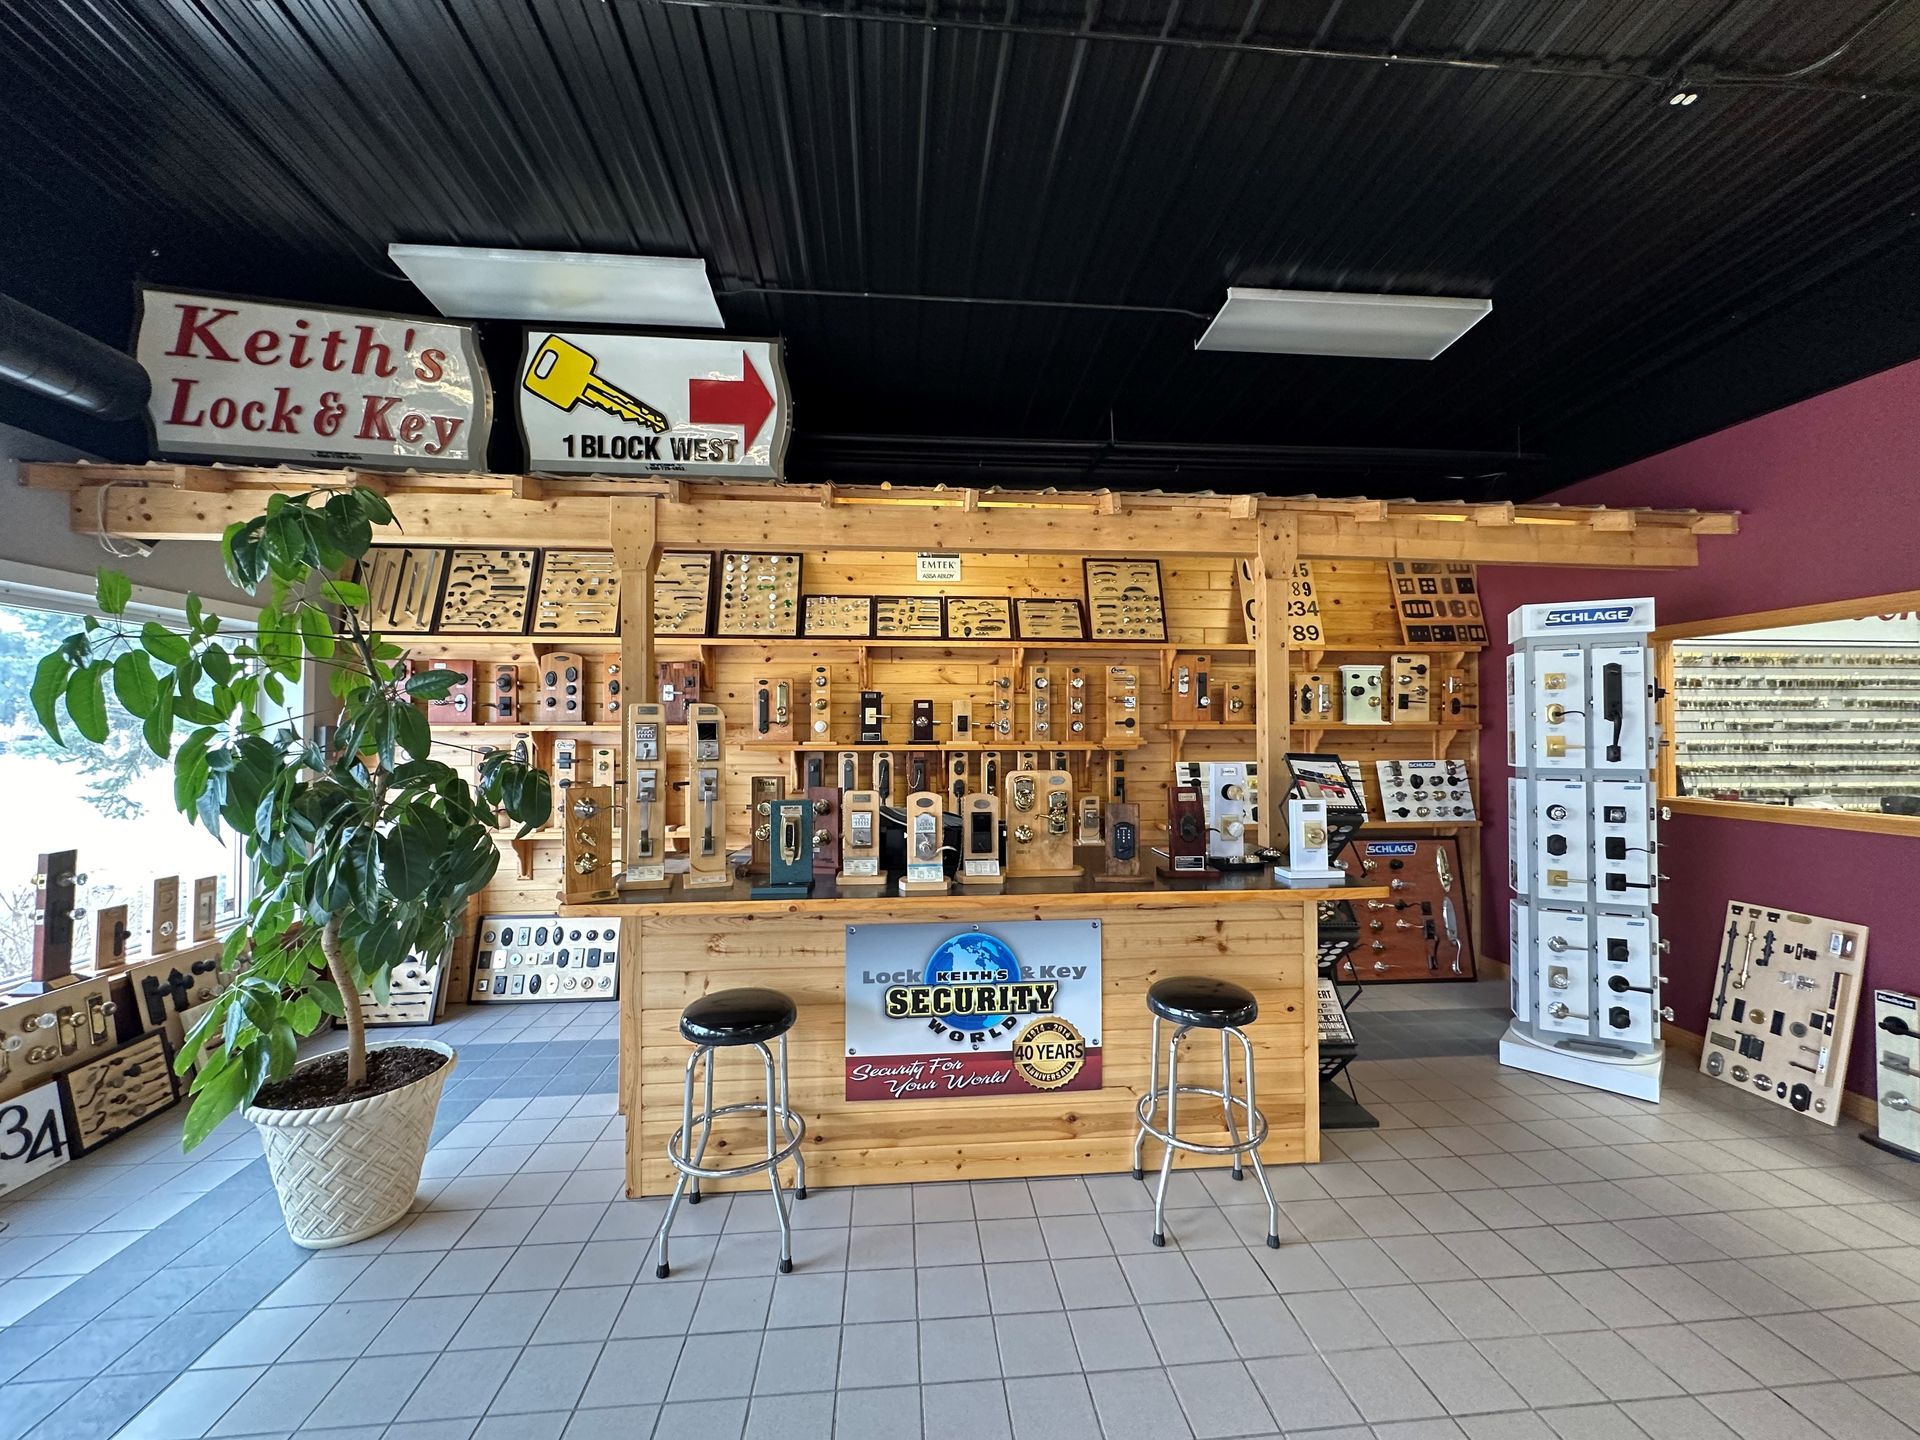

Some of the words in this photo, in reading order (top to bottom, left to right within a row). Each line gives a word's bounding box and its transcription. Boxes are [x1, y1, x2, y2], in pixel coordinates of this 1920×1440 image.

[165, 303, 446, 382] Keith's
[164, 378, 302, 435] Lock
[313, 391, 347, 436] &
[354, 394, 464, 455] Key
[562, 434, 575, 458] 1
[581, 434, 661, 461] BLOCK
[669, 436, 739, 462] WEST
[921, 560, 955, 569] EMTEK
[1545, 610, 1630, 623] SCHLAGE
[1367, 845, 1414, 854] SCHLAGE
[862, 968, 922, 984] Lock
[1021, 965, 1035, 979] &
[1040, 965, 1087, 980] Key
[937, 970, 1008, 982] KEITH'S
[888, 984, 1055, 1015] SECURITY
[927, 1016, 1017, 1043] WORLD
[1015, 1045, 1034, 1061] 40
[1036, 1042, 1084, 1060] YEARS
[850, 1060, 924, 1081] Security
[926, 1057, 964, 1075] For
[1025, 1063, 1073, 1081] ANNIVERSARY
[884, 1078, 938, 1098] Your
[944, 1069, 1011, 1091] World
